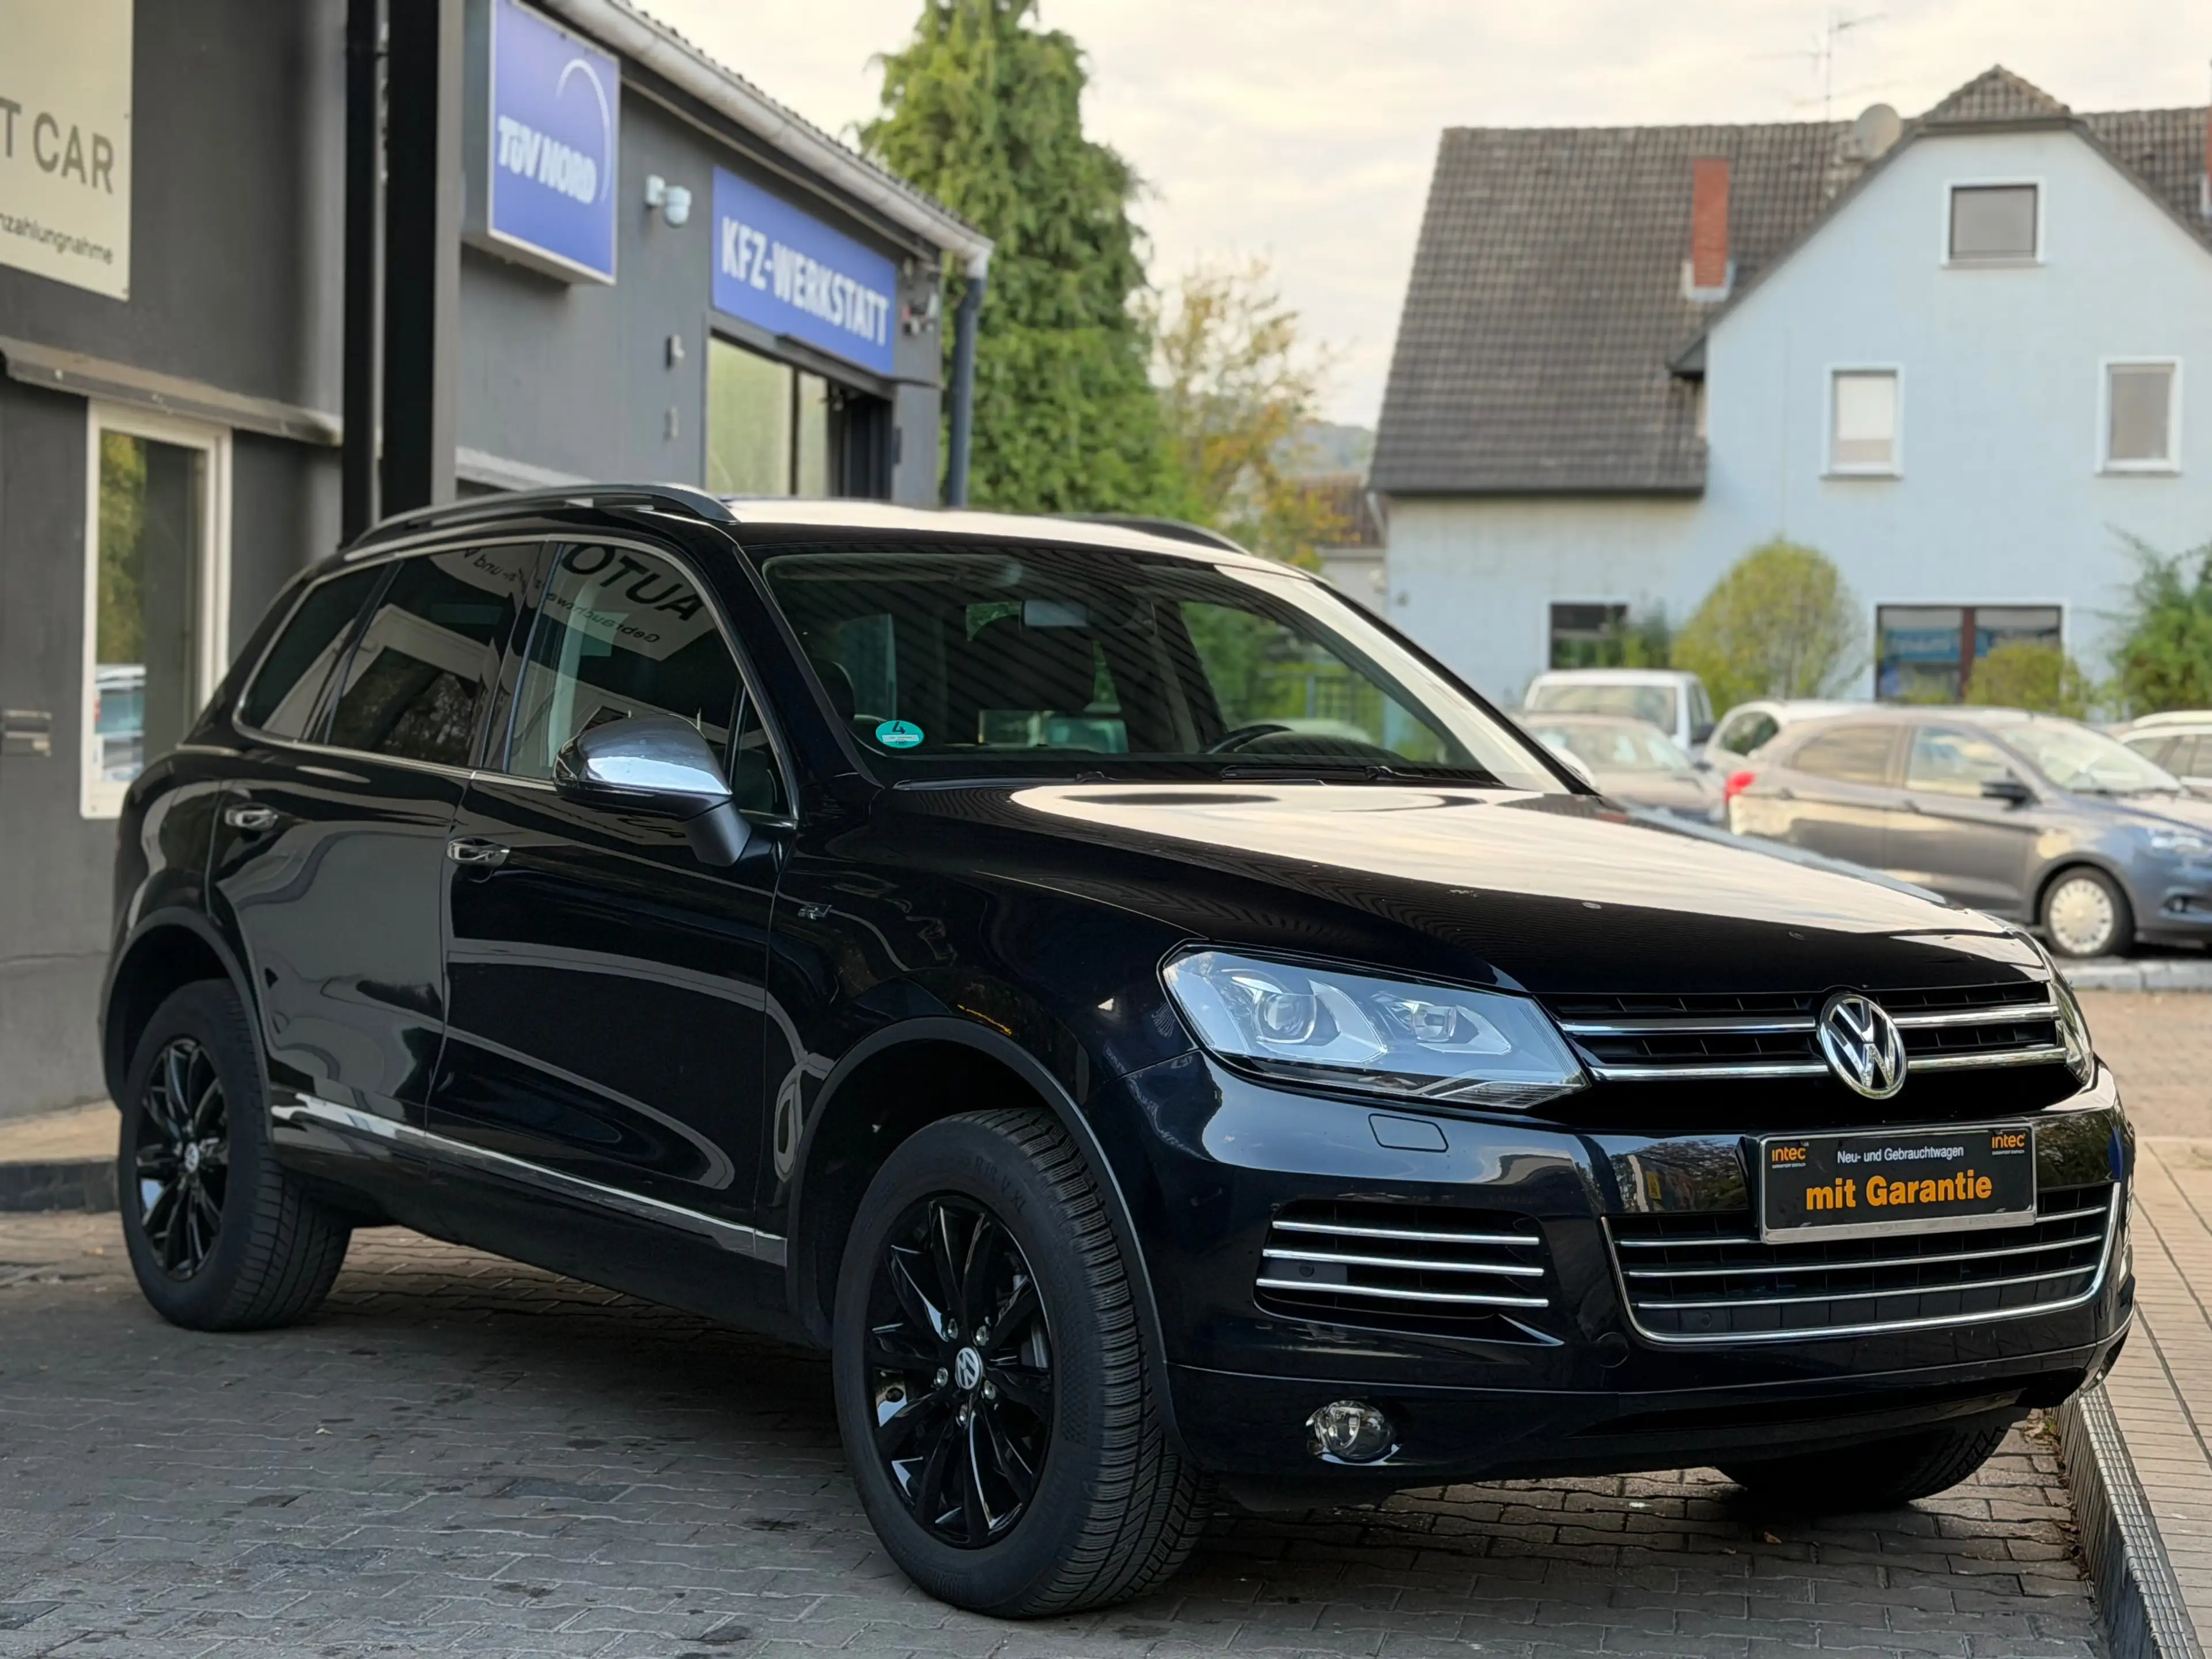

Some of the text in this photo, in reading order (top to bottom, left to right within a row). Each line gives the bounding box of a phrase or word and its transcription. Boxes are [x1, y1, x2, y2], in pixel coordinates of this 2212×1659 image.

[32, 112, 113, 195] CAR
[497, 114, 597, 205] TÜV NORD
[721, 215, 890, 347] KFZ-WERKSTATT
[892, 721, 906, 734] 4
[1837, 1146, 1964, 1164] Neu- und Gebrauchtwagen
[1806, 1169, 1993, 1210] mit Garantie
